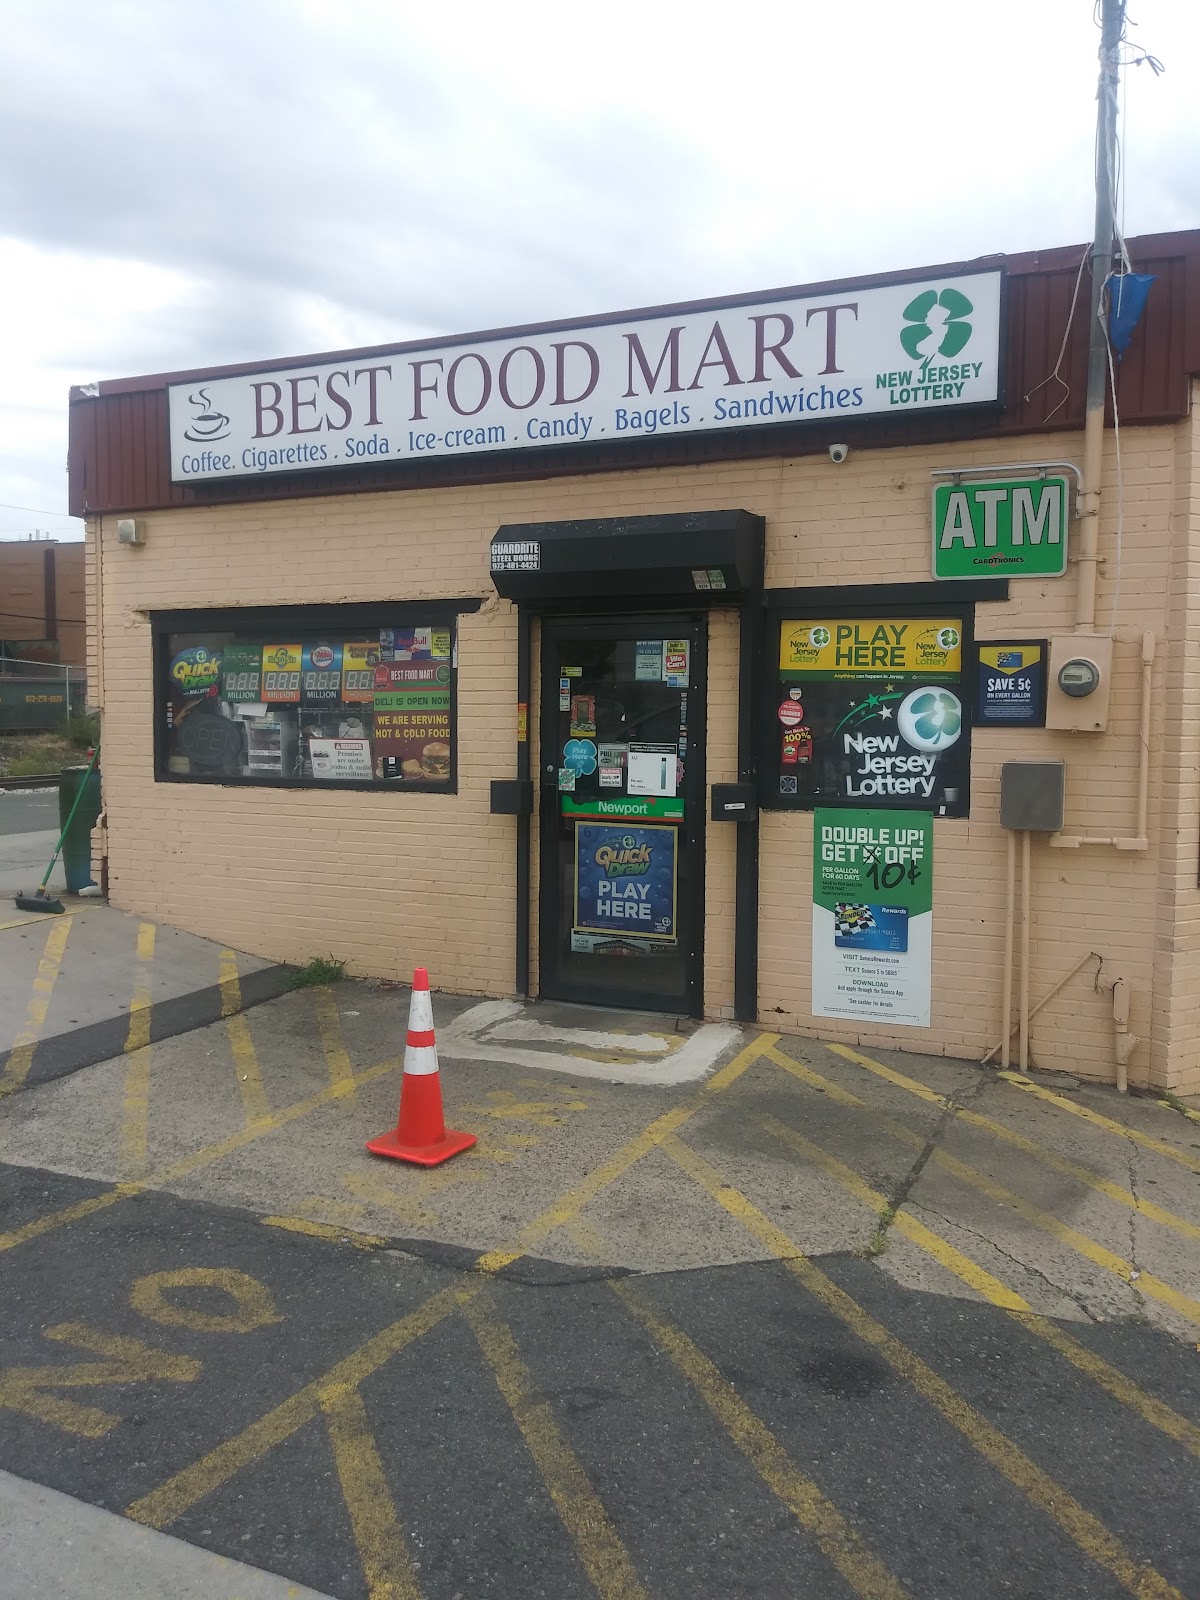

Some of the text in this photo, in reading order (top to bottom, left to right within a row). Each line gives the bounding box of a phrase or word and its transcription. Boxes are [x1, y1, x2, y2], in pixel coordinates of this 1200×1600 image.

[250, 302, 859, 440] BEST FOOD MART
[876, 362, 983, 389] NEW JERSEY
[889, 381, 965, 405] LOTTERY
[241, 442, 328, 472] Cigarettes
[345, 434, 390, 458] Soda
[408, 425, 506, 453] Ice-cream
[526, 411, 593, 441] Candy
[614, 401, 691, 433] Bagels
[714, 385, 863, 421] Sandwiches
[938, 485, 1062, 550] ATM
[492, 542, 539, 555] GUARDRITE
[492, 554, 539, 563] STEEL DOORS
[414, 636, 427, 646] Bull
[836, 624, 909, 646] PLAY
[790, 640, 809, 648] New
[915, 642, 936, 650] New
[793, 647, 820, 657] Jersey
[835, 646, 906, 667] HERE
[919, 650, 949, 660] Jersey
[790, 655, 820, 664] Lottery
[915, 657, 948, 667] Lottery
[173, 657, 221, 683] Quick
[390, 669, 404, 681] BEST
[404, 669, 418, 680] FOOD
[418, 669, 434, 680] MART
[987, 678, 1031, 692] SAVE 5¢
[227, 691, 256, 699] MILLION
[267, 691, 296, 699] MILLION
[306, 690, 338, 699] MILLION
[375, 697, 450, 706] DELI IS OPEN NOW
[377, 714, 448, 725] WE ARE SERVING
[375, 728, 450, 738] HOT & COLD FOOD
[784, 731, 812, 743] 100%
[843, 733, 899, 755] New
[572, 747, 588, 755] Play
[600, 750, 613, 758] PULL
[857, 753, 937, 776] Jersey
[335, 770, 369, 778] surveillance
[845, 775, 937, 798] Lottery
[598, 801, 648, 816] Newport
[822, 826, 924, 846] DOUBLE UP!
[595, 843, 653, 872] Quick
[821, 844, 860, 863] GET
[885, 846, 924, 866] OFF
[607, 862, 651, 878] Draw
[834, 866, 859, 875] GALLON
[867, 859, 922, 891] 10¢
[598, 880, 651, 900] PLAY
[597, 899, 652, 920] HERE
[840, 911, 866, 920] SUNOCO
[881, 907, 907, 915] Rewards
[859, 955, 900, 964] SunocoRewards.com
[852, 979, 889, 988] DOWNLOAD
[0, 1266, 287, 1440] NO
